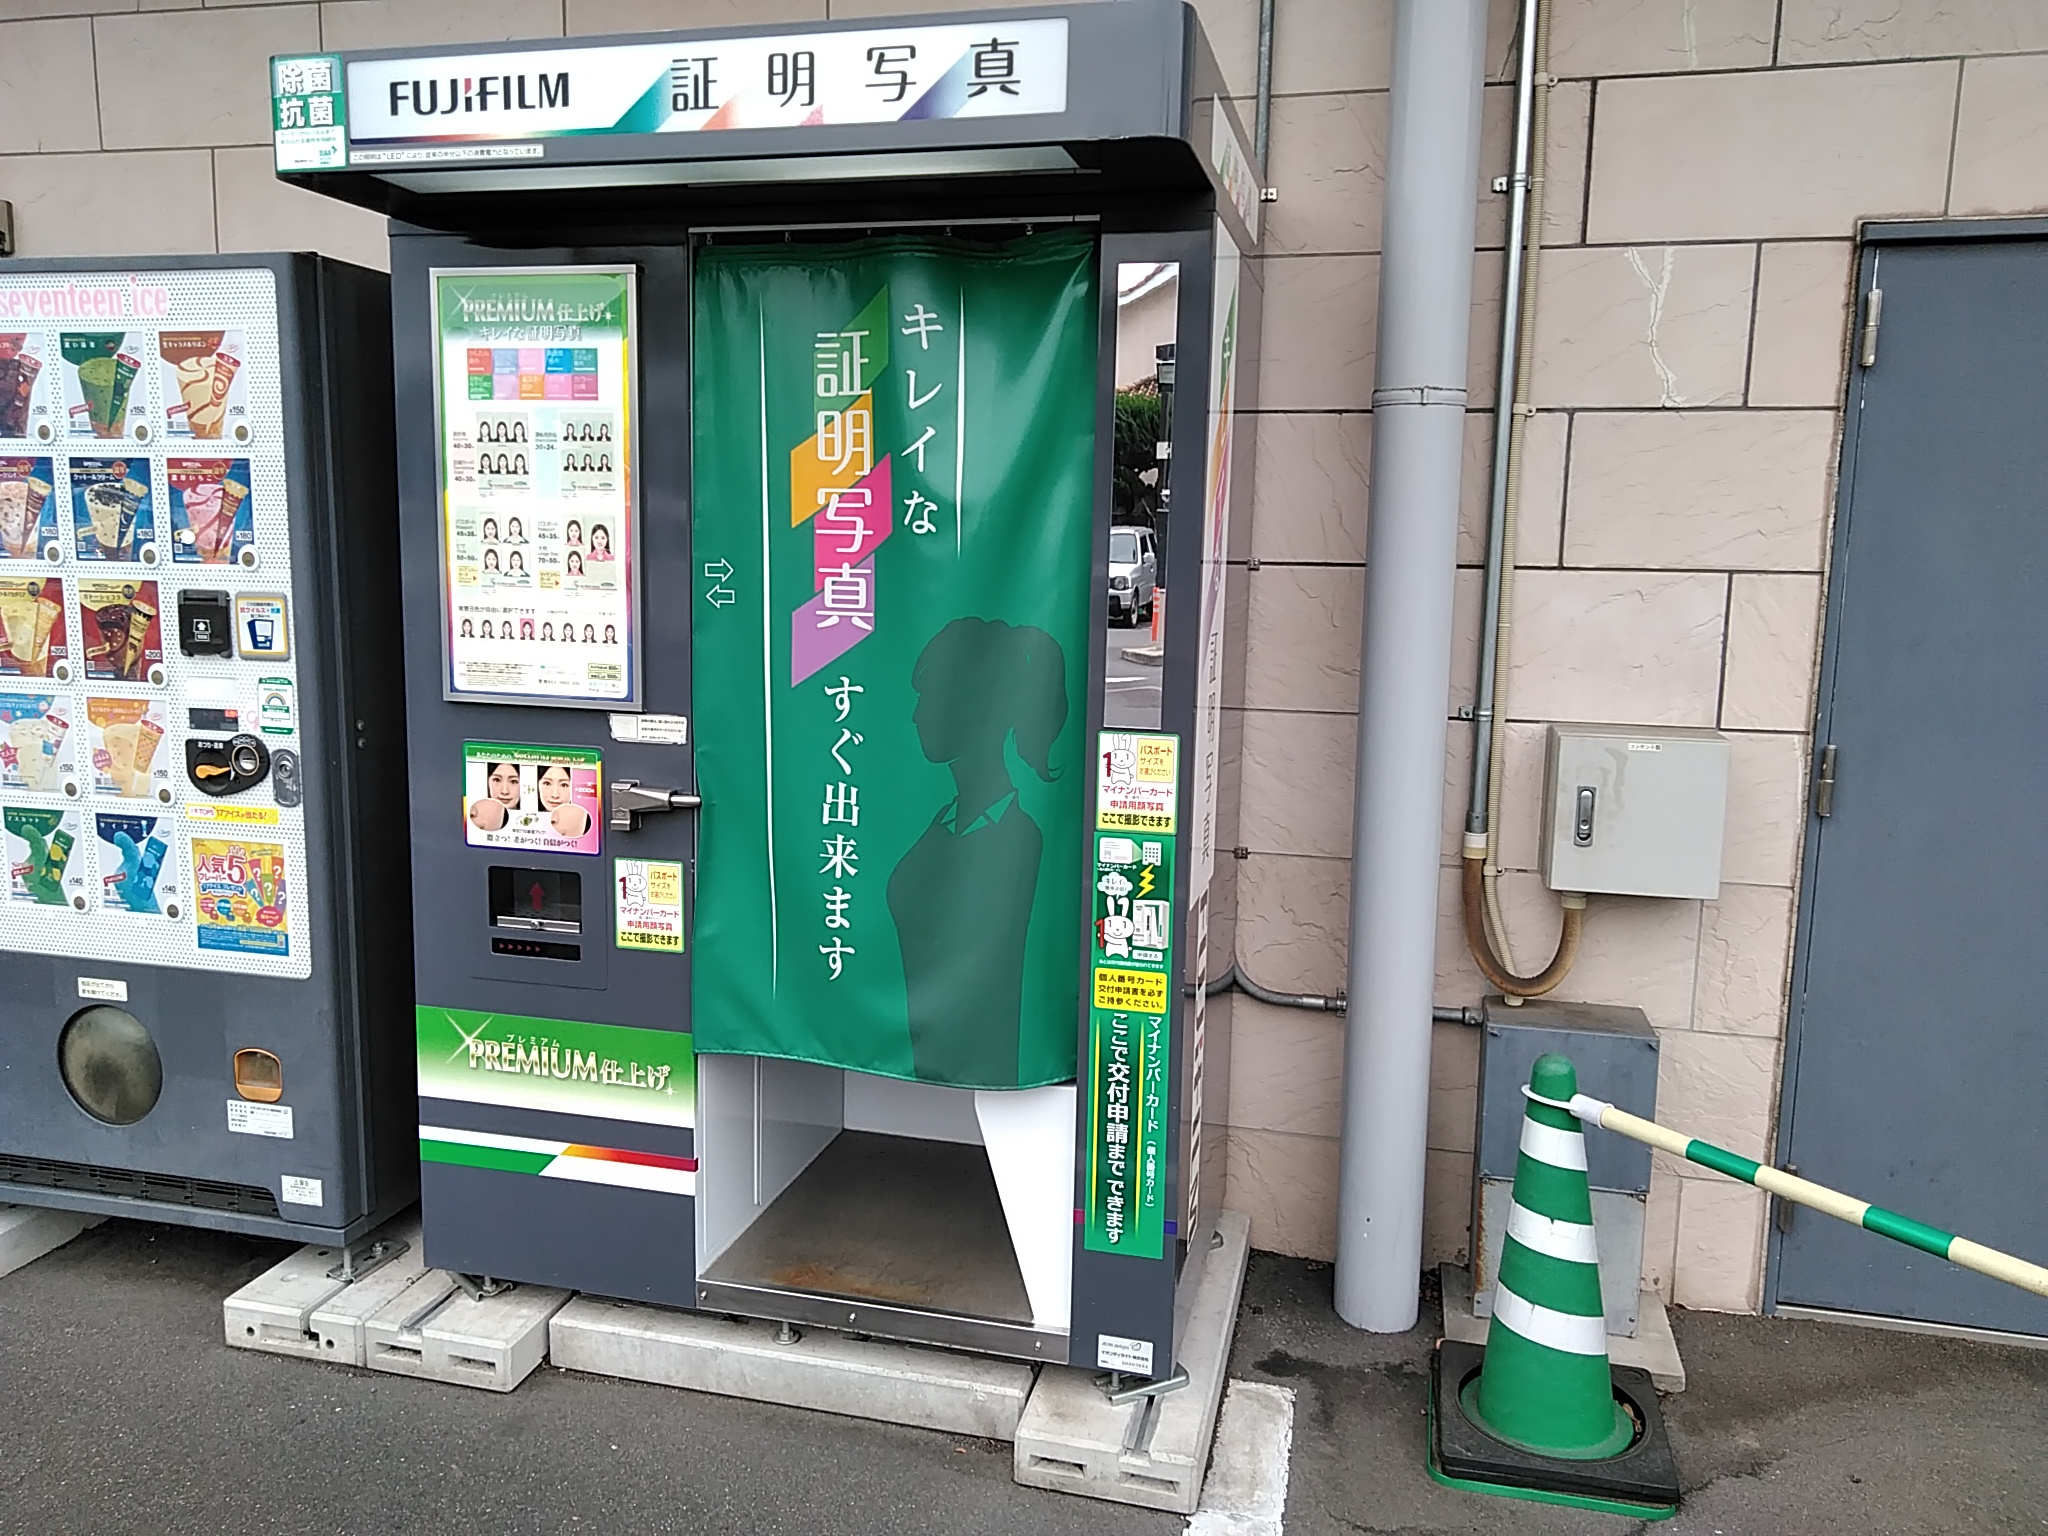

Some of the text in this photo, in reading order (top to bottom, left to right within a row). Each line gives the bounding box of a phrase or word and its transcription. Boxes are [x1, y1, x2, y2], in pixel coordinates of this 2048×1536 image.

[277, 62, 332, 95] 除菌
[670, 37, 1021, 112] 証明写真
[389, 72, 569, 116] FUJIFILM
[280, 96, 334, 128] 抗菌
[0, 276, 168, 318] seventeen ice
[901, 304, 943, 534] キレイな
[814, 330, 874, 631] 証明写真
[1102, 785, 1174, 798] マイナンバーカード
[818, 676, 864, 981] すぐ出来ます
[1102, 812, 1172, 828] ここで撮影できます
[197, 855, 246, 885] 人気 5
[620, 931, 680, 946] ここで撮影できます
[1098, 973, 1163, 986] 個人番号カード
[1098, 984, 1164, 998] 交付申請書を必ず
[1098, 995, 1163, 1010] ご持参ください。
[506, 1034, 561, 1048] プレミアム
[1145, 1015, 1164, 1133] マイナンバーカード
[1105, 1012, 1131, 1244] ここで交付申請までできます
